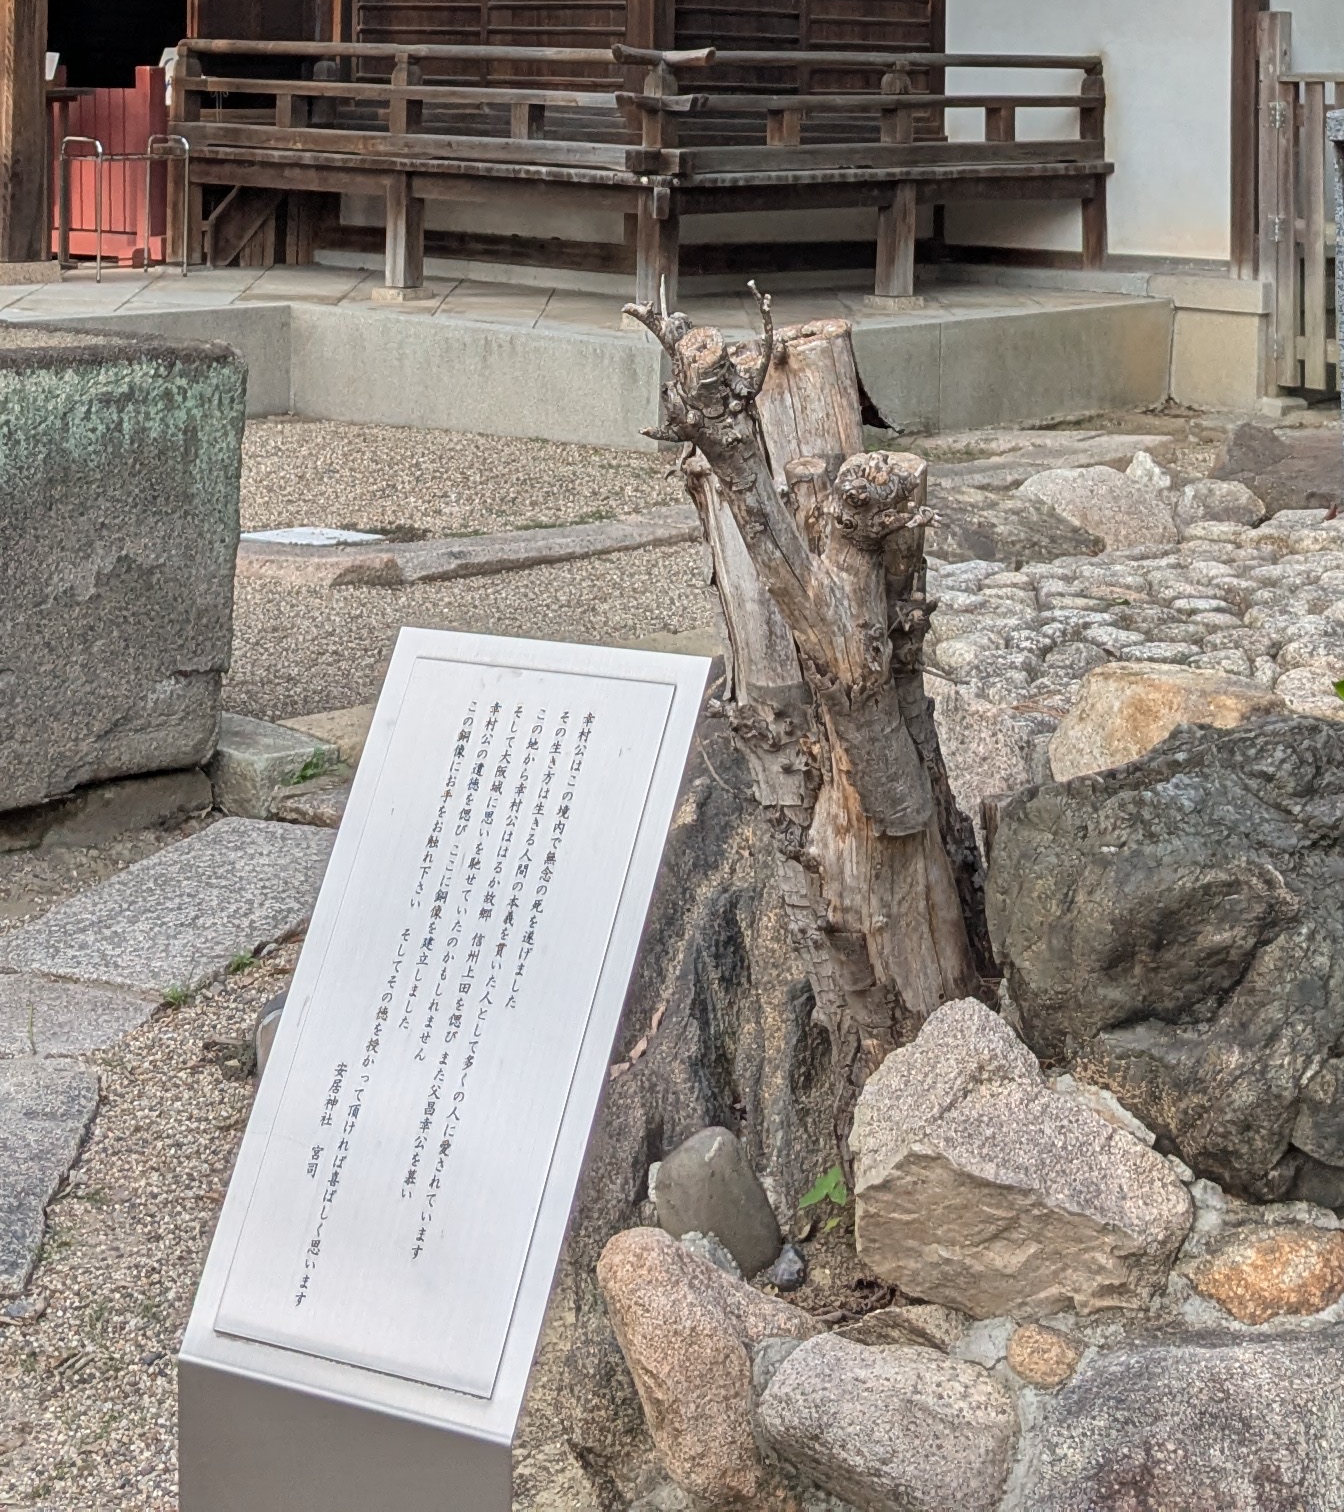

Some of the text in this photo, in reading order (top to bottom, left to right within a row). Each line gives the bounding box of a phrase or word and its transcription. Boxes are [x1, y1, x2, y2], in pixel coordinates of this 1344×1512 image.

[409, 699, 479, 909] この銅像にお手をお触れ下さい
[412, 704, 524, 1063] そして大阪城に思いを馳せていたのかもしれません
[503, 710, 597, 1010] 幸村公はこの境内で無念の死を遂げました
[305, 1061, 349, 1180] 安居神社 宮司
[410, 709, 571, 1261] その生き方は生きる人間の本義を貫いた人として多くの人に愛されています
